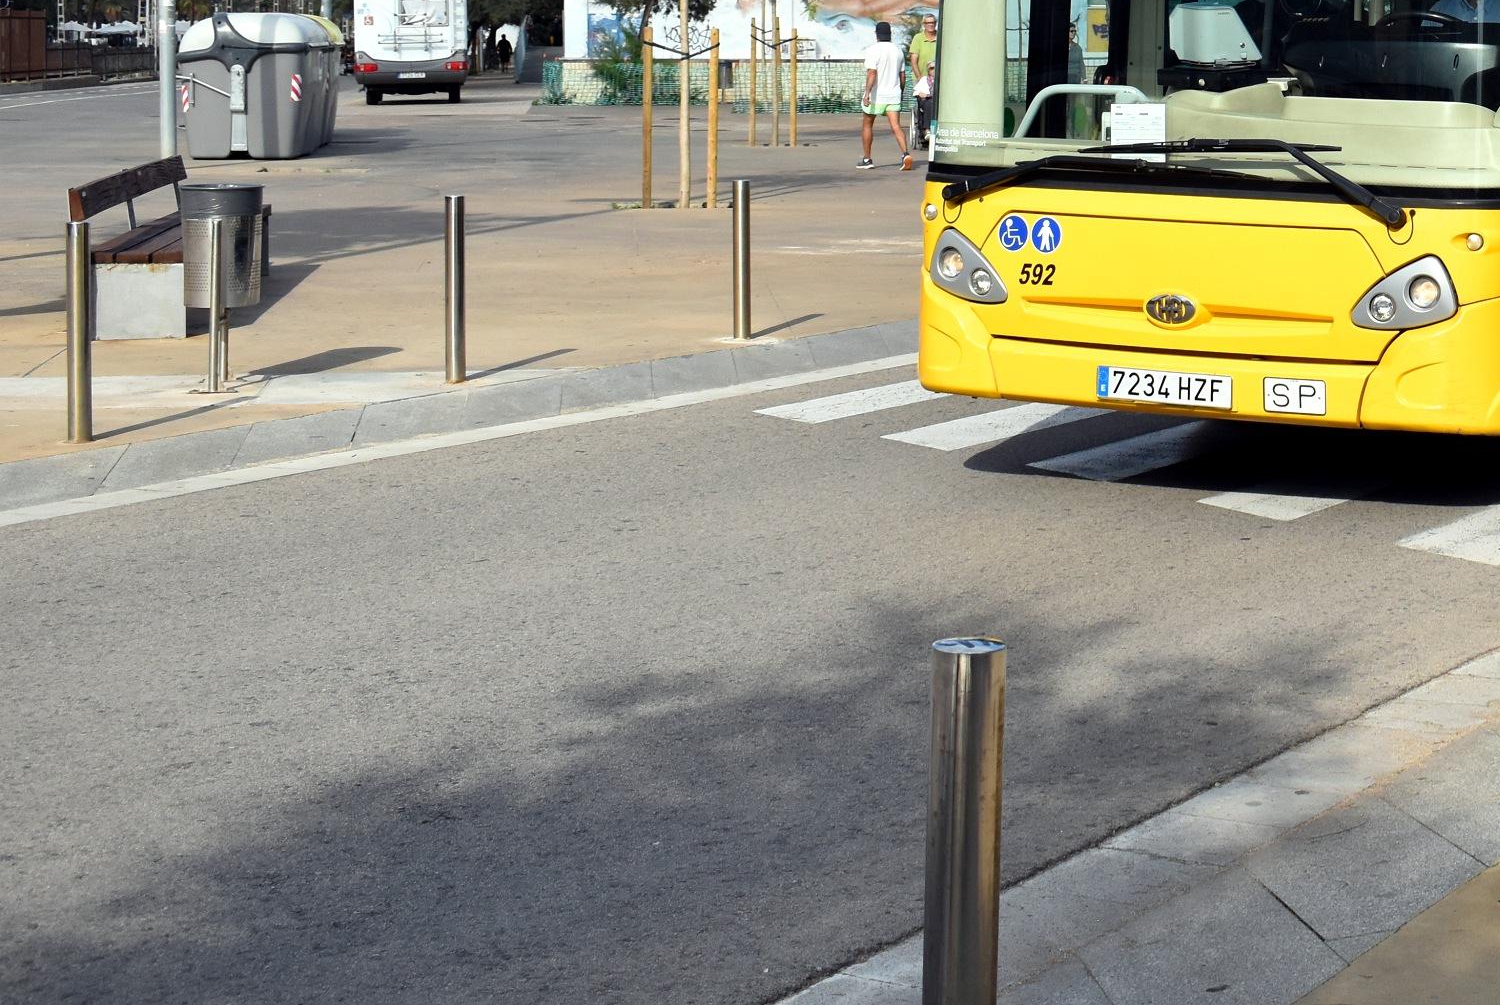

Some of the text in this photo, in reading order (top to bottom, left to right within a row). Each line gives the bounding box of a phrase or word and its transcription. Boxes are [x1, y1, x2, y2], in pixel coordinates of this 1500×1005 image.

[961, 127, 998, 139] Barcelona
[1018, 263, 1056, 286] 592
[1112, 370, 1170, 399] 7234
[1178, 376, 1223, 402] HZF
